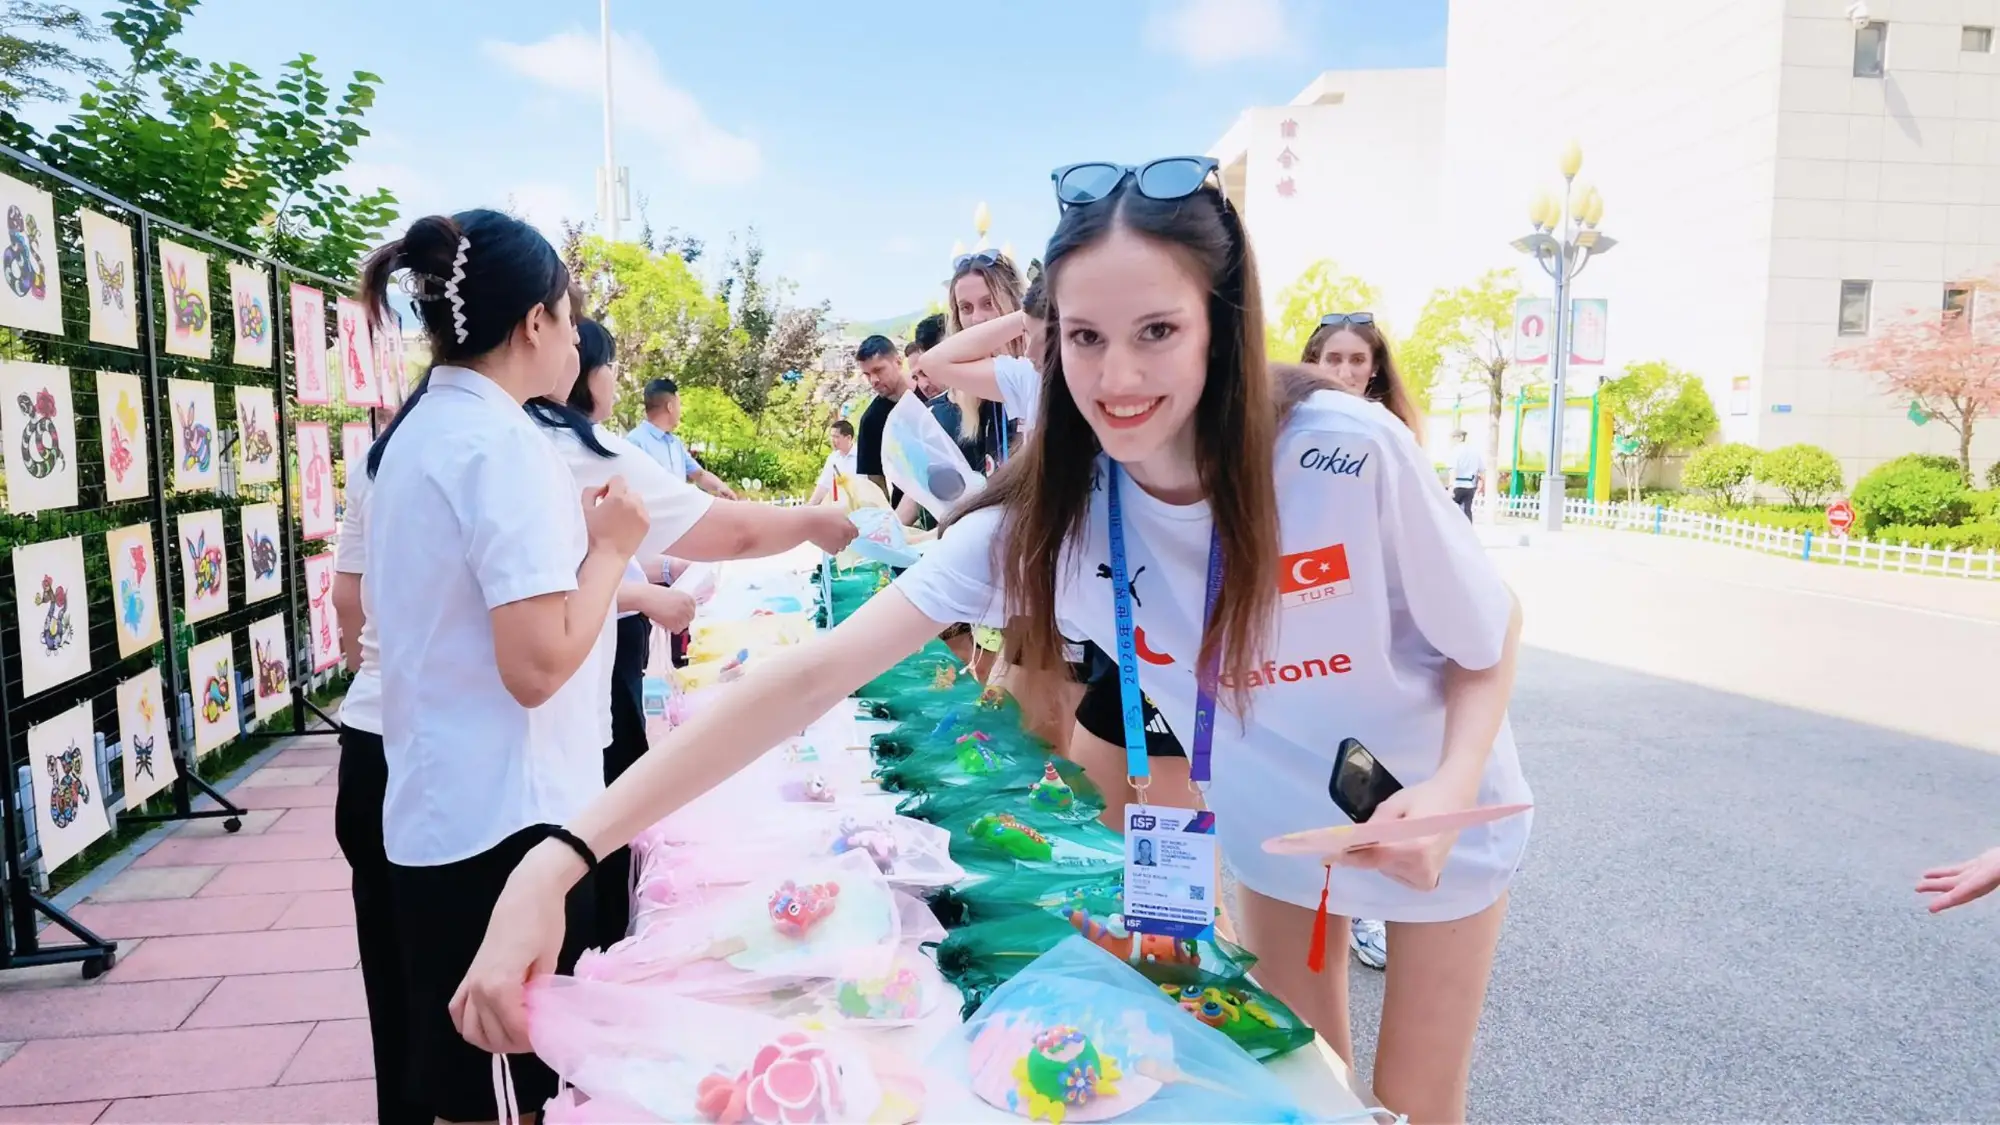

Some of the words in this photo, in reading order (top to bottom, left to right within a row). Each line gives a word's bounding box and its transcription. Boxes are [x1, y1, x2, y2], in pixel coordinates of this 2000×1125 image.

[1299, 446, 1370, 478] Orkid
[1297, 585, 1336, 603] TUR
[1132, 816, 1154, 829] ISF
[1126, 918, 1142, 928] ISF
